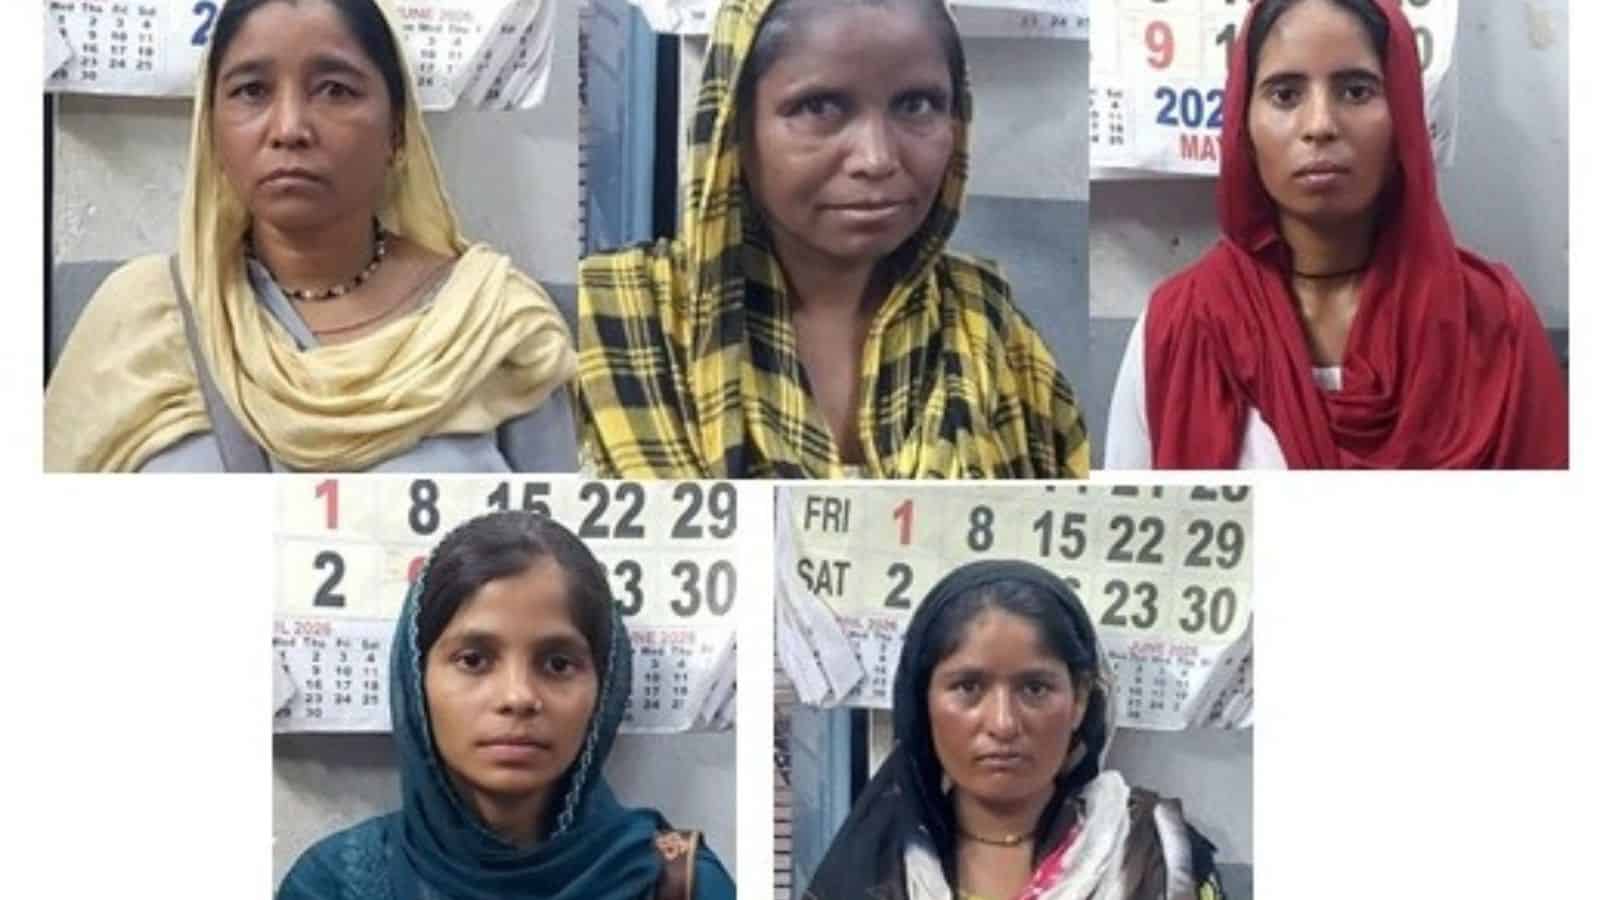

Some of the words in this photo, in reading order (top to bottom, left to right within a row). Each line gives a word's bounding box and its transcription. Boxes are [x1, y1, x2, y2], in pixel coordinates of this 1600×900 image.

[111, 30, 127, 40] 10
[138, 33, 152, 42] 11
[111, 45, 126, 55] 17
[1145, 20, 1174, 69] 9
[81, 55, 97, 66] 23
[109, 58, 126, 69] 24
[1154, 86, 1225, 128] 202
[315, 479, 338, 530] 1
[408, 479, 440, 535] 8
[579, 482, 645, 539] 22
[671, 482, 738, 539] 29
[803, 495, 851, 533] FRI
[893, 499, 913, 545] 1
[968, 504, 994, 551] 8
[1033, 510, 1087, 559] 15
[1106, 515, 1165, 563] 22
[1184, 519, 1245, 569] 29
[313, 551, 345, 608] 2
[671, 560, 738, 618] 30
[797, 558, 851, 597] SAT
[885, 562, 913, 608] 2
[1100, 579, 1159, 629] 23
[1180, 585, 1237, 634] 30
[336, 666, 352, 676] 10
[364, 667, 378, 677] 11
[644, 673, 660, 683] 10
[673, 673, 688, 682] 11
[306, 679, 321, 690] 16
[336, 680, 351, 689] 17
[364, 680, 379, 691] 18
[644, 686, 660, 696] 17
[305, 693, 322, 703] 23
[334, 693, 352, 704] 24
